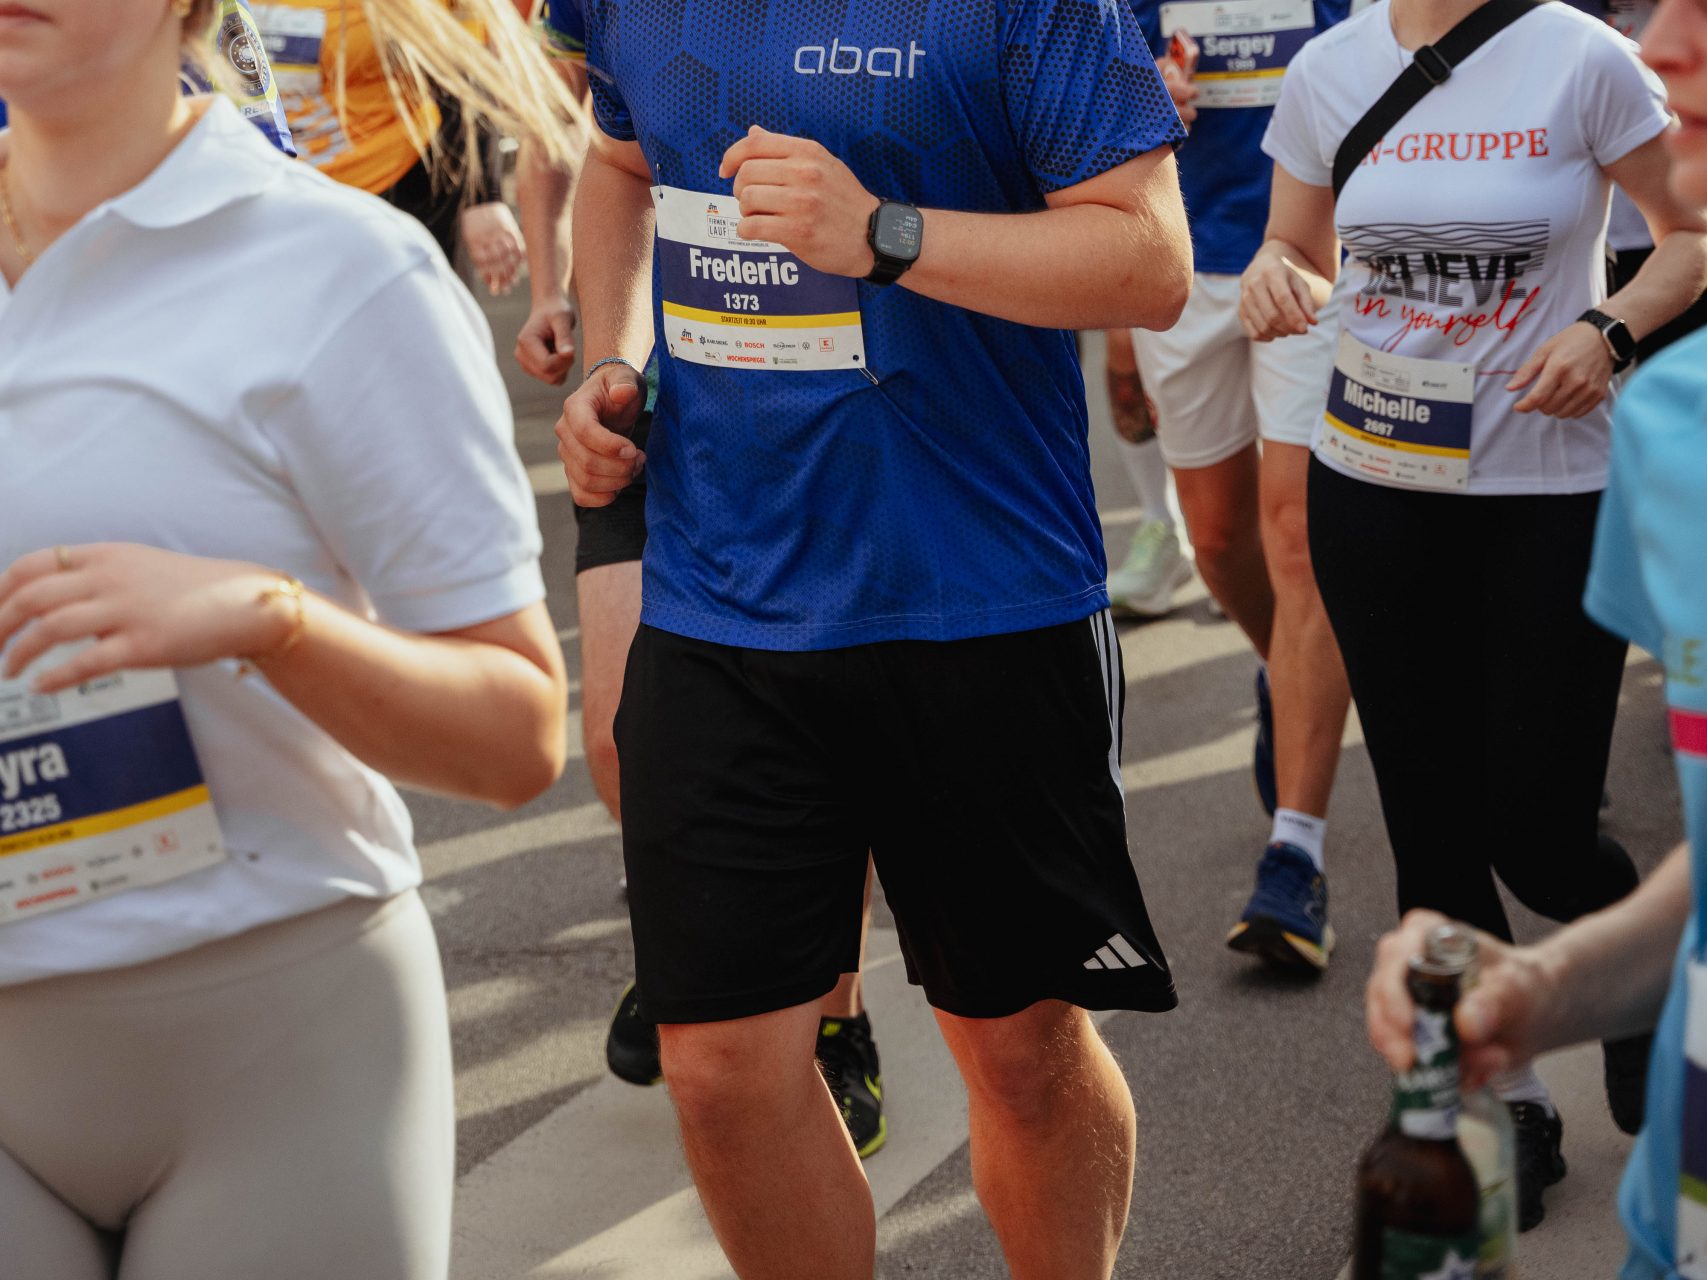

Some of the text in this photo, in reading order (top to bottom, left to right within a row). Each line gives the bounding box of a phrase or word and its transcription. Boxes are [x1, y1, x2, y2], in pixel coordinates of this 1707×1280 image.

[794, 37, 926, 79] abat
[1203, 34, 1276, 58] Sergey
[709, 225, 727, 236] LAUF
[689, 247, 799, 286] Frederic
[723, 292, 760, 311] 1373
[1355, 280, 1542, 353] in yourself
[681, 328, 692, 339] dm
[744, 341, 765, 349] BOSCH
[726, 355, 766, 363] WOCHENSPIEGEL
[1343, 379, 1431, 424] Michelle
[0, 793, 62, 832] 2325
